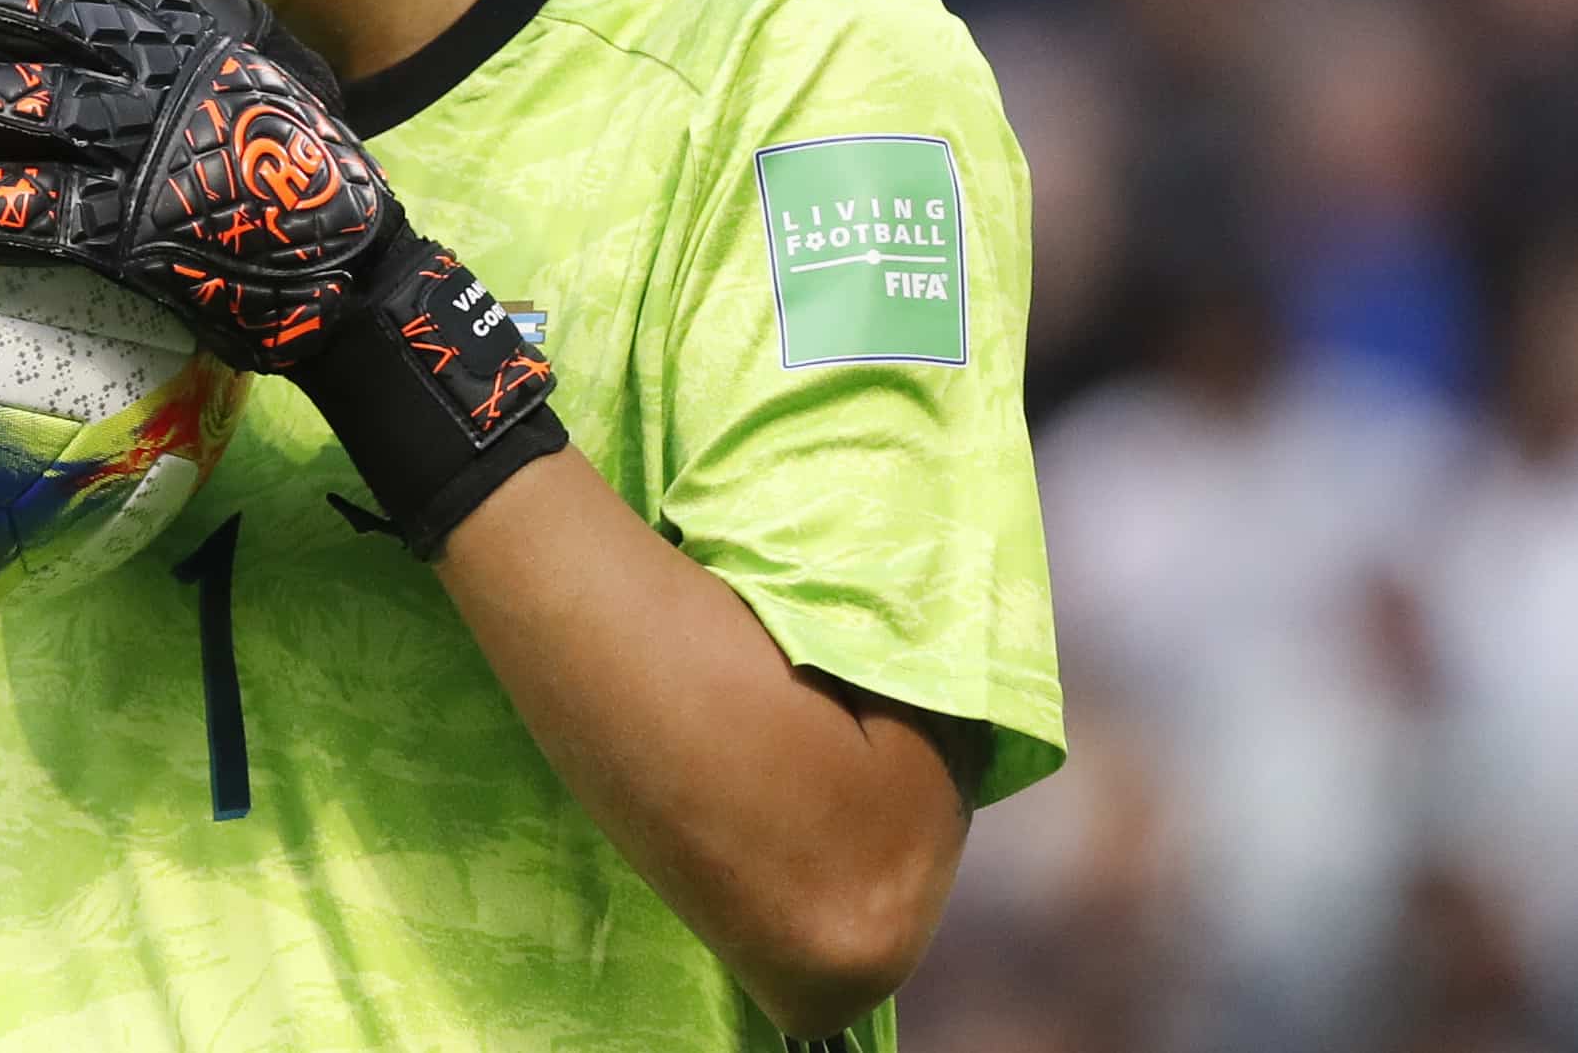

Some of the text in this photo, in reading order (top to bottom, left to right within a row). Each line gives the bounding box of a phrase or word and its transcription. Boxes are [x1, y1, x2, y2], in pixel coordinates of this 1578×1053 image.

[782, 197, 946, 231] LIVING
[785, 223, 946, 256] FOOTBALL
[172, 510, 252, 822] 1
